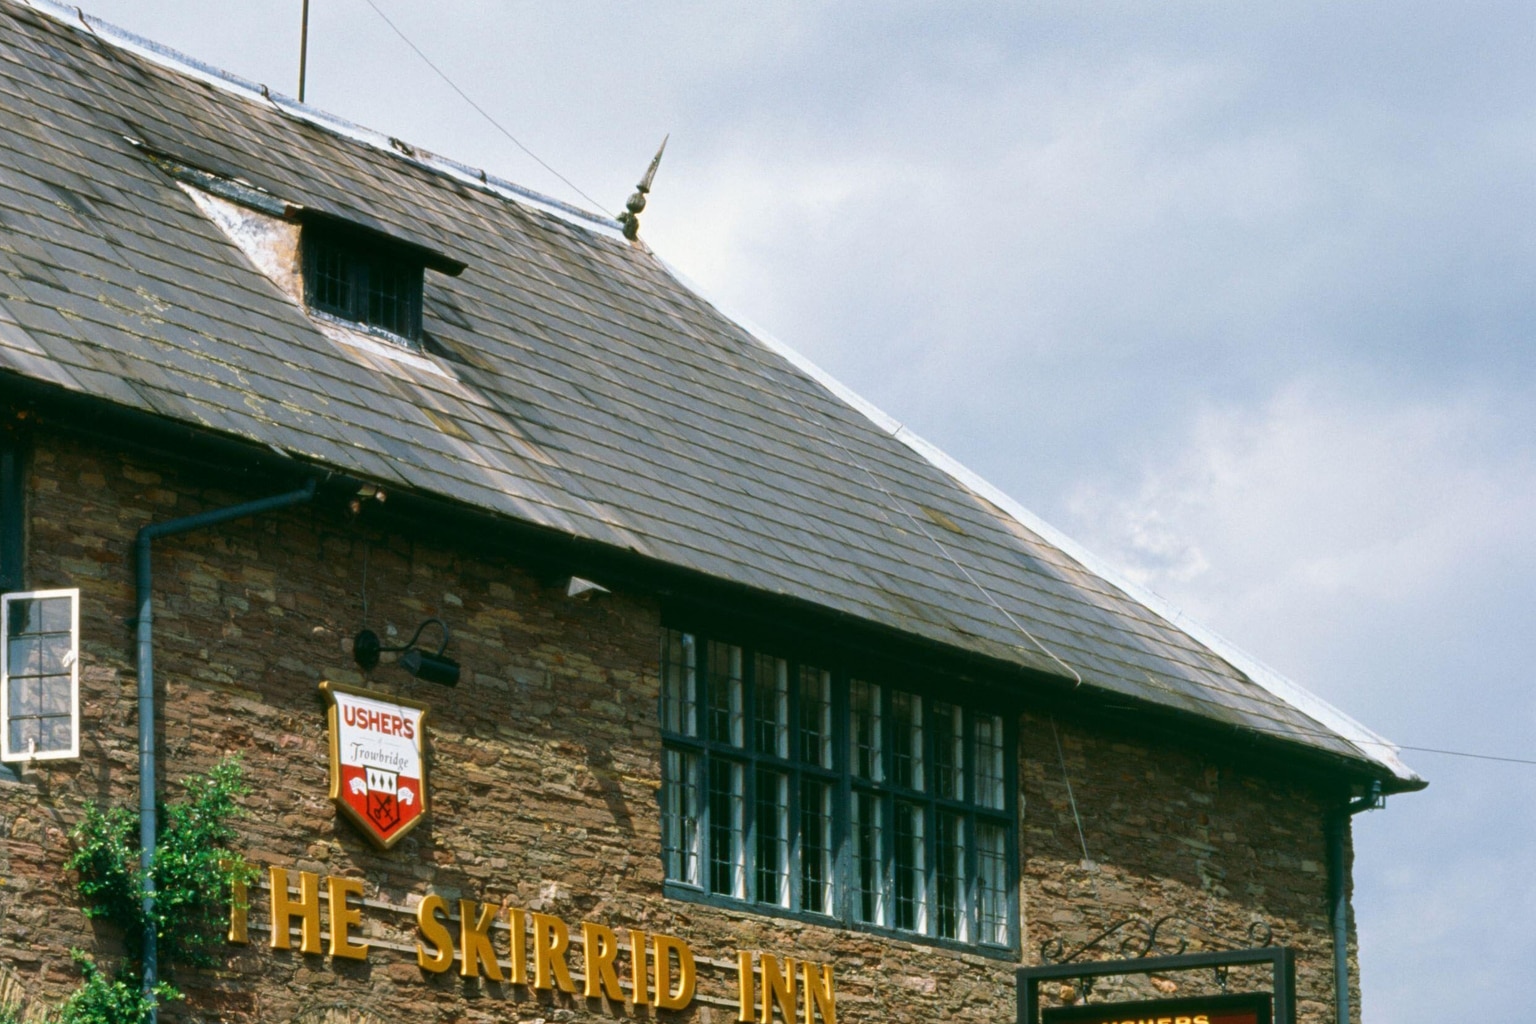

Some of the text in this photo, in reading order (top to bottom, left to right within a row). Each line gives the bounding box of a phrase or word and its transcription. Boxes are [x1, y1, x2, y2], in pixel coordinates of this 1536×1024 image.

[343, 704, 415, 740] USHERS
[350, 741, 409, 770] Trowbridge
[218, 859, 369, 960] THE
[417, 895, 697, 1011] SKIRRID
